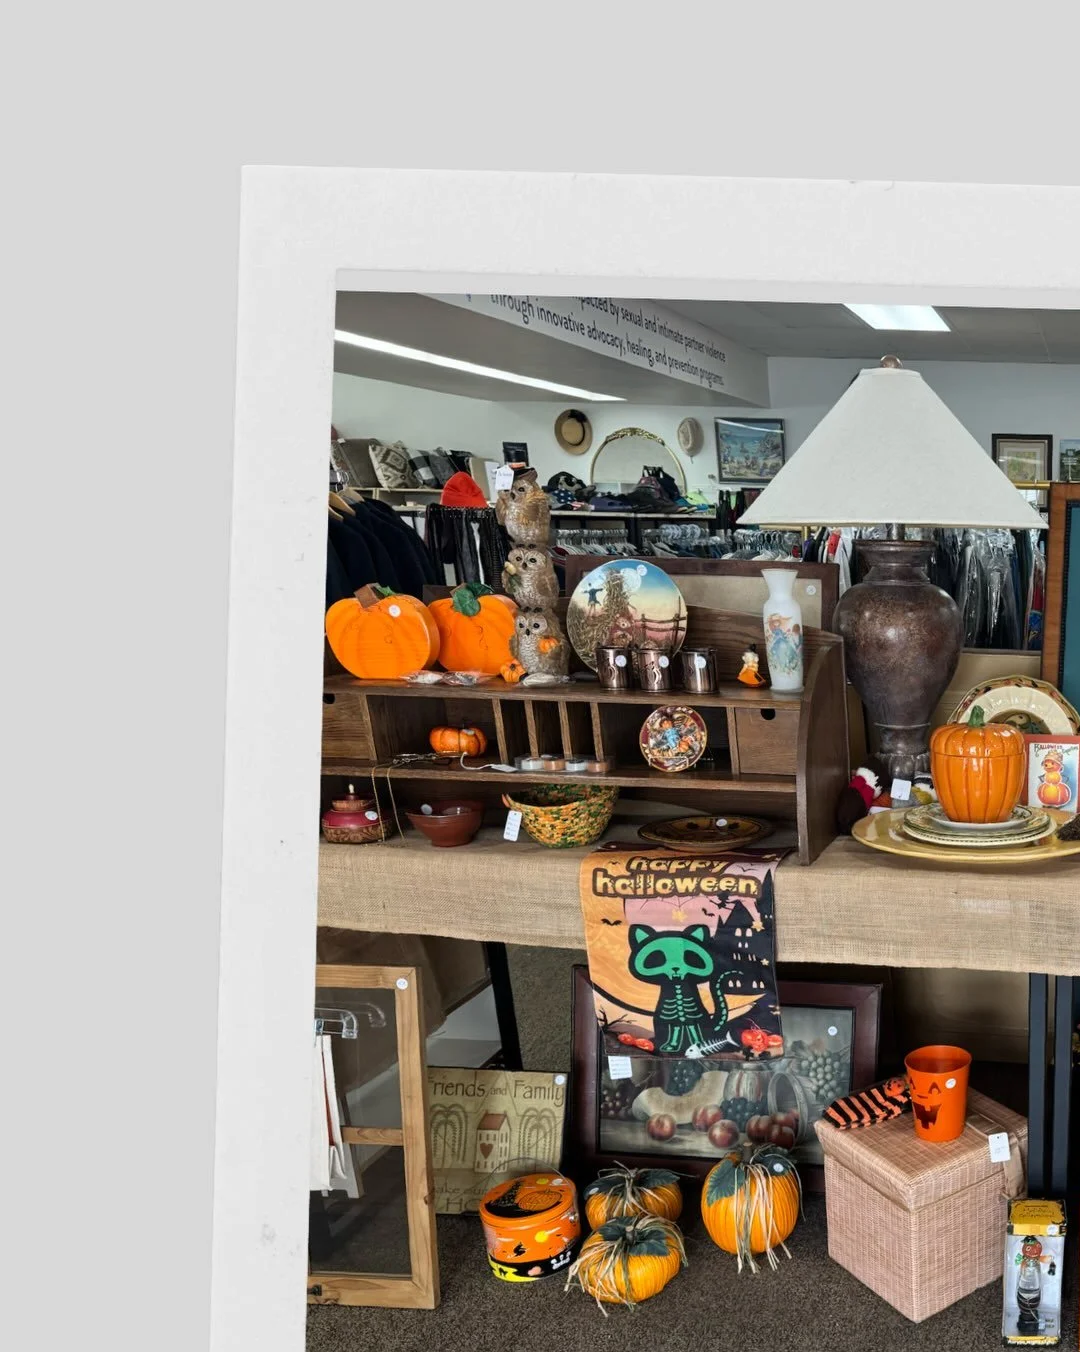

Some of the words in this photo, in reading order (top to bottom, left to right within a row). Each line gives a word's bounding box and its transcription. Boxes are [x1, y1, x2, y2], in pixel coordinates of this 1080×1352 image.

[490, 295, 535, 325] through
[536, 298, 585, 335] innovative
[587, 320, 626, 357] advocacy,
[626, 332, 655, 367] healing,
[655, 347, 667, 365] and
[668, 357, 699, 375] prevention
[610, 297, 620, 325] by
[621, 307, 644, 329] sexual
[645, 315, 657, 333] and
[658, 318, 684, 345] intimate
[684, 336, 705, 353] partner
[705, 341, 726, 362] violence
[627, 857, 731, 875] happy
[595, 870, 759, 896] halloween
[489, 1086, 507, 1096] and
[513, 1079, 566, 1108] Family
